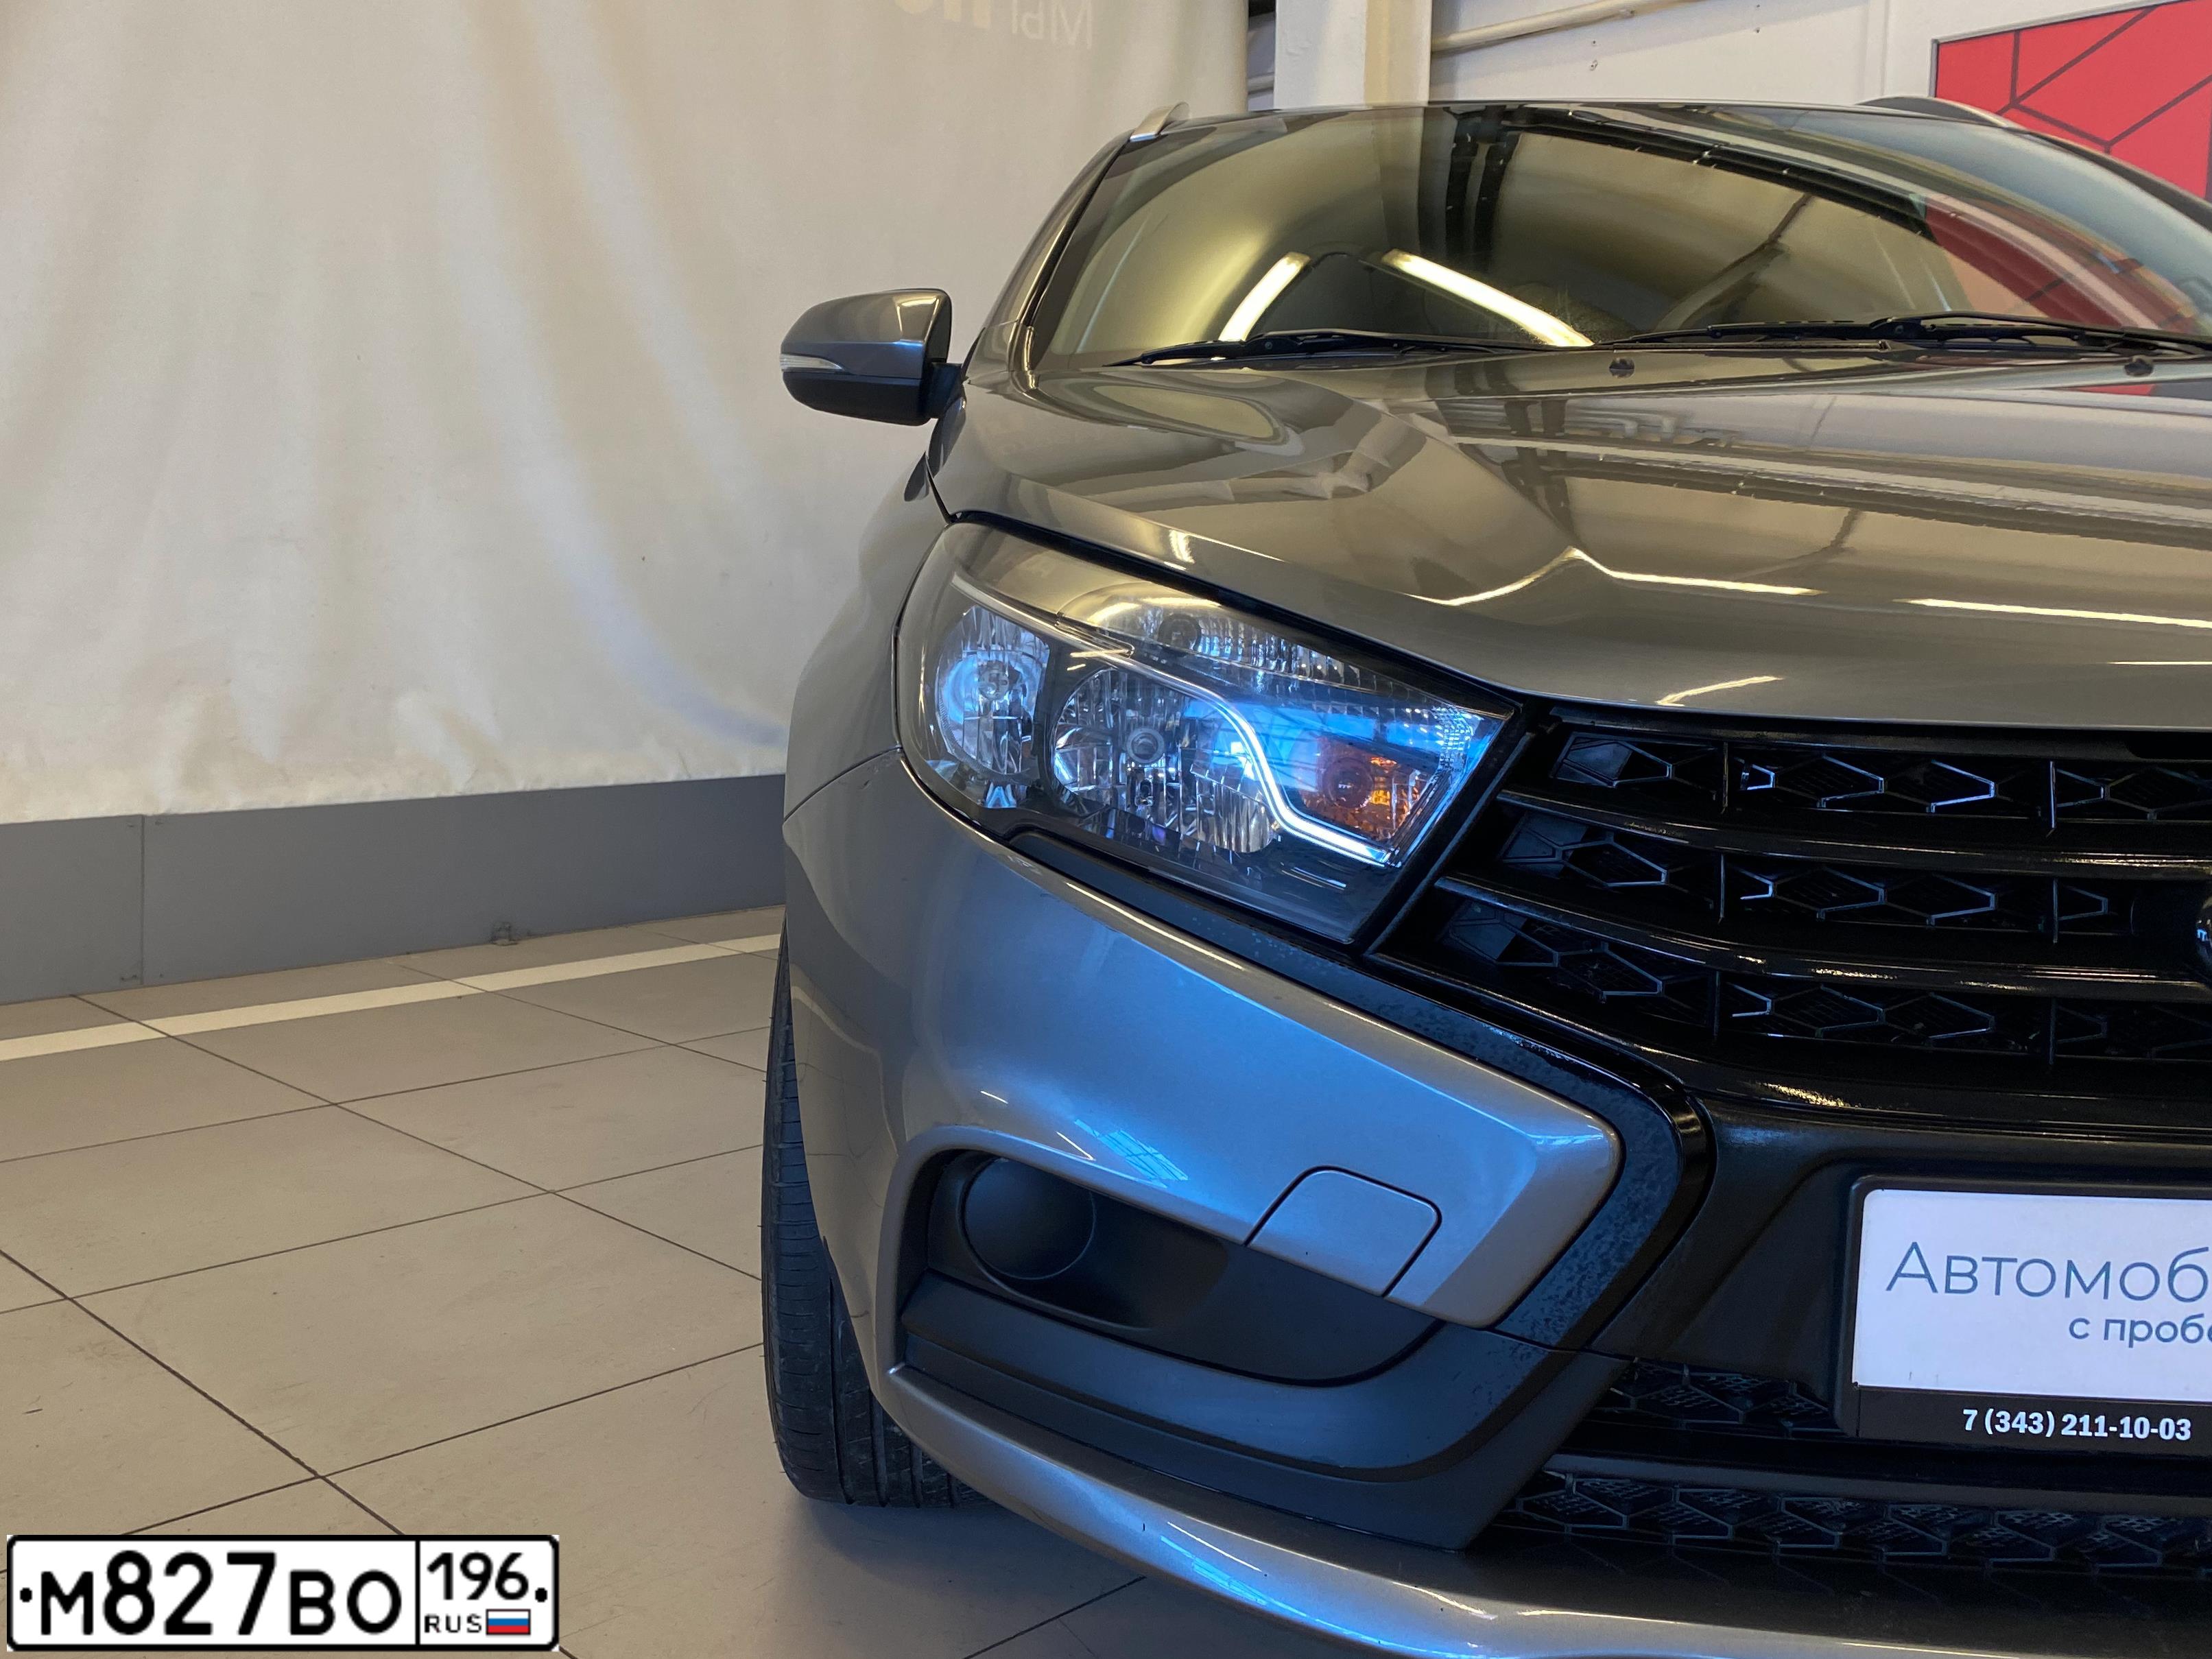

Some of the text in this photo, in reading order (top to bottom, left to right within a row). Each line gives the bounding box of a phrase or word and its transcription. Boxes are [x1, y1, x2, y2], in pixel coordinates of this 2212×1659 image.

[2069, 1313, 2212, 1348] с проб
[1963, 1408, 2192, 1441] 7 (343) 211-10-03
